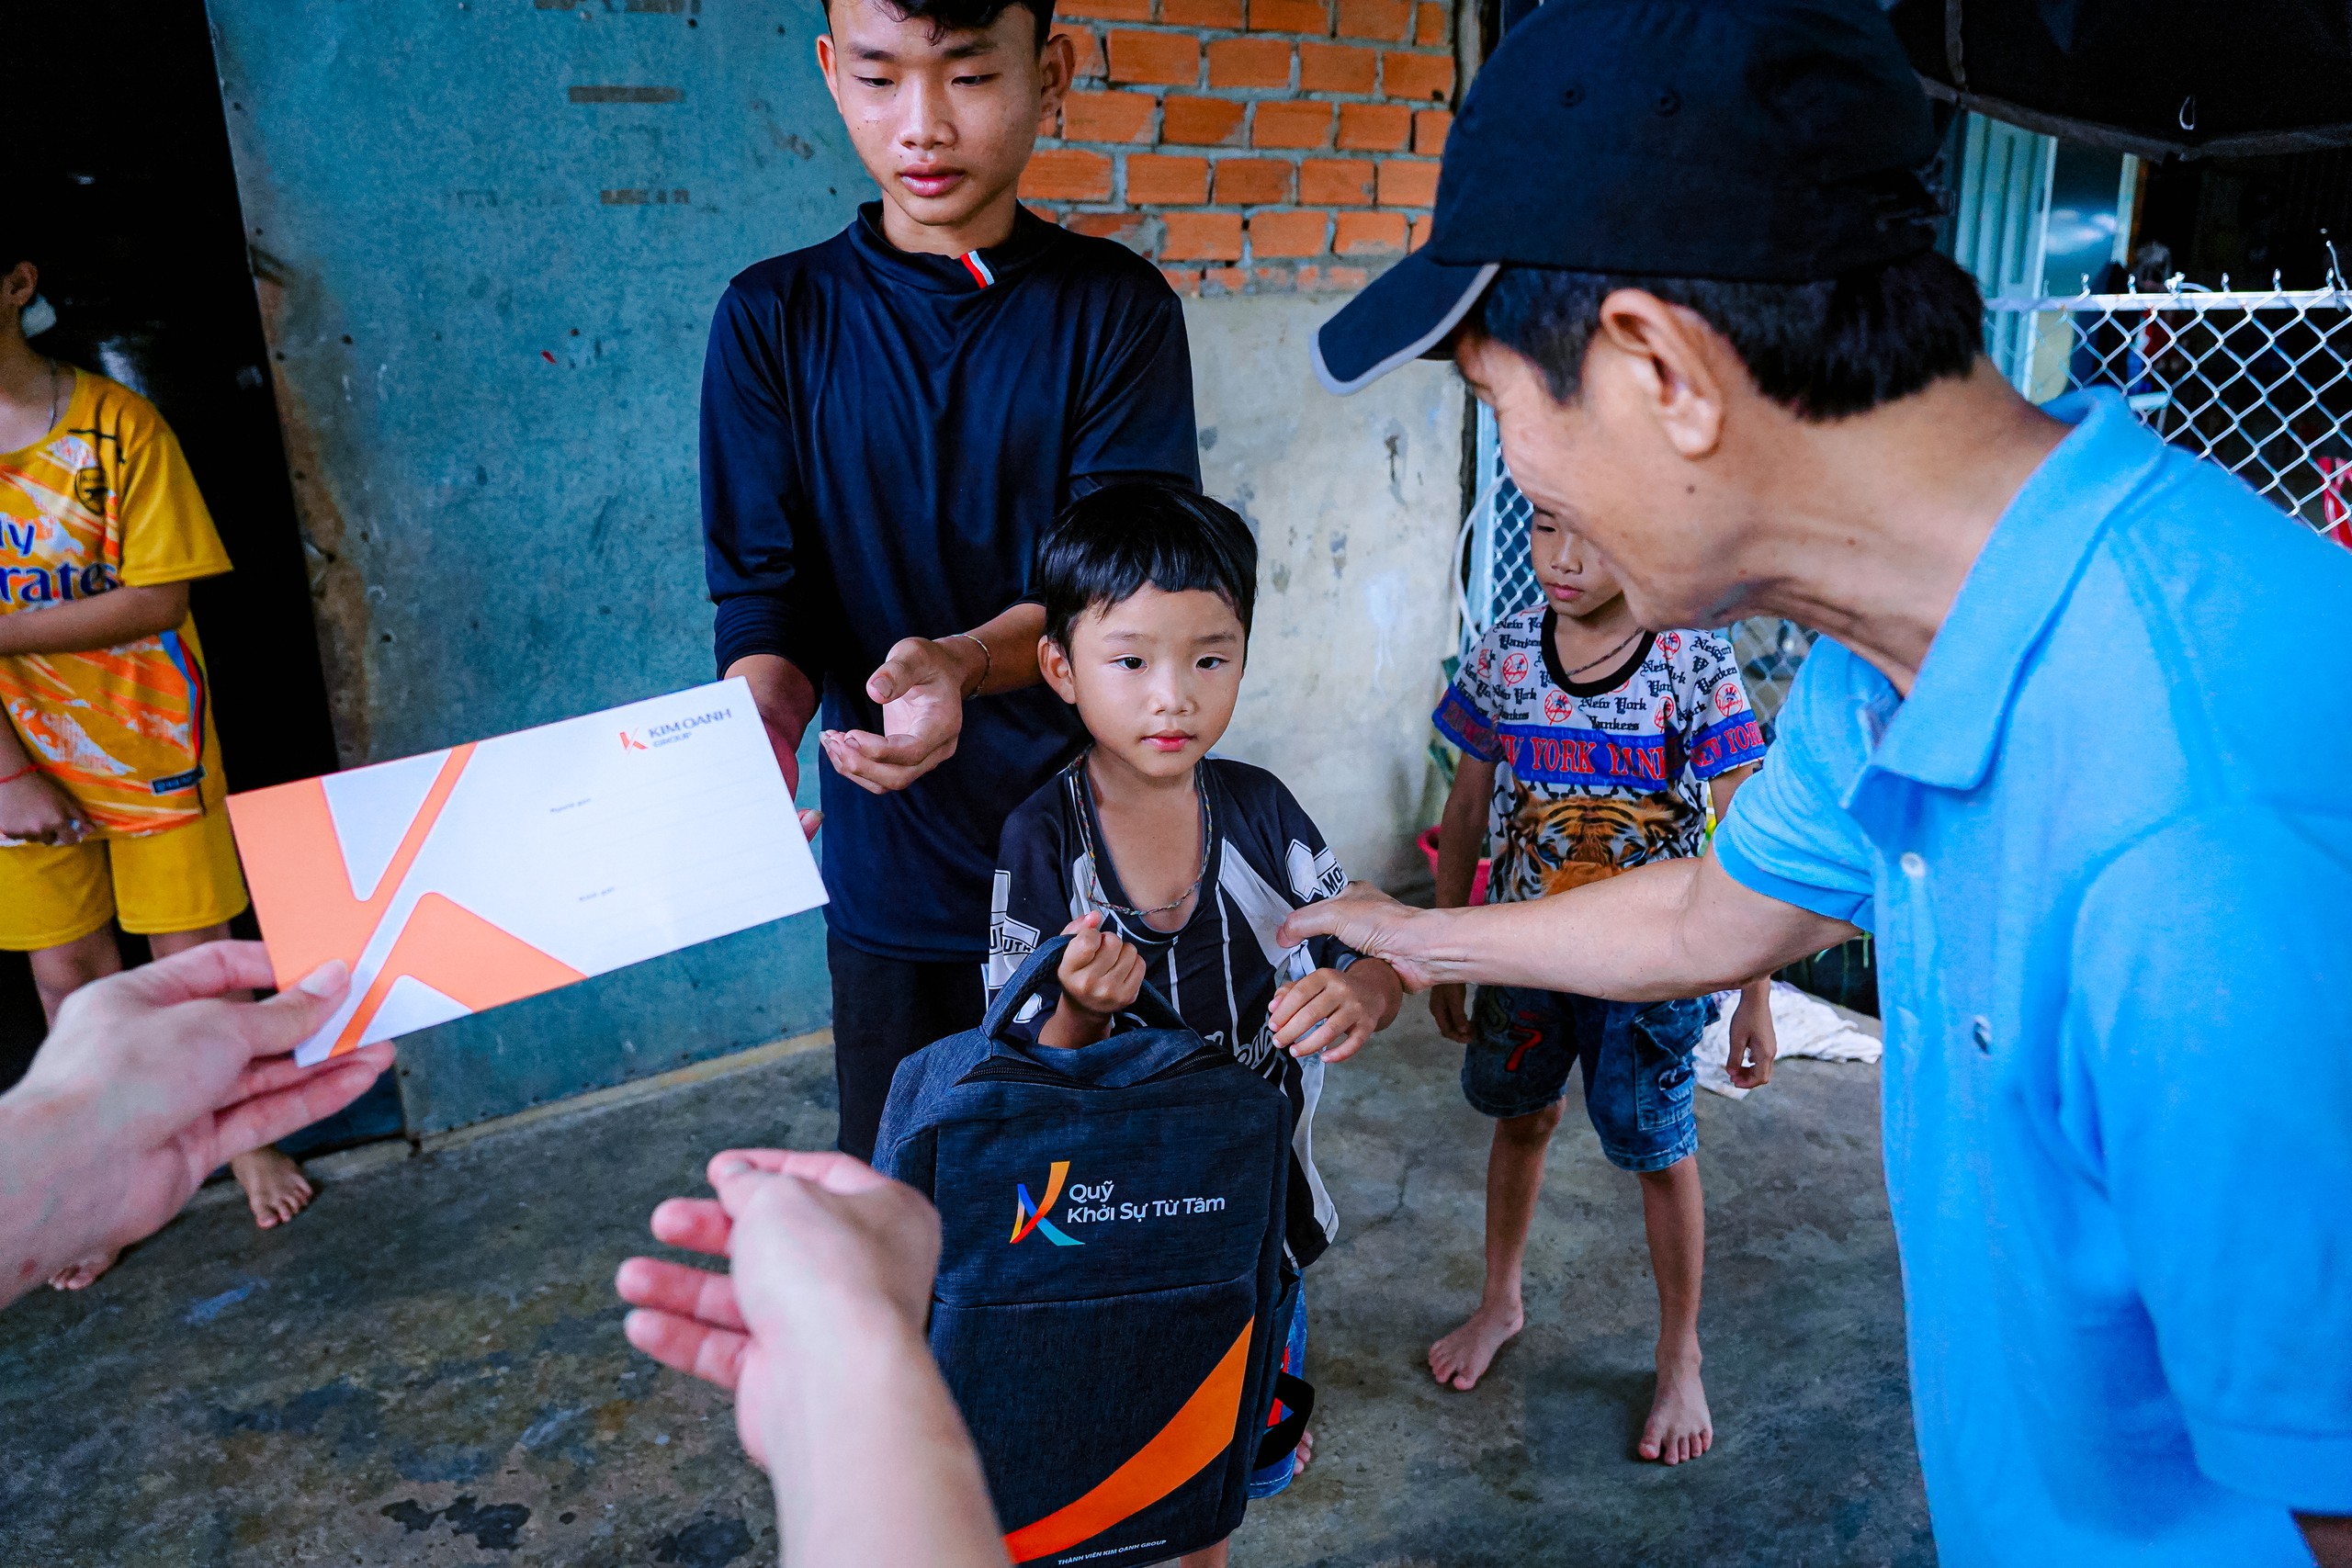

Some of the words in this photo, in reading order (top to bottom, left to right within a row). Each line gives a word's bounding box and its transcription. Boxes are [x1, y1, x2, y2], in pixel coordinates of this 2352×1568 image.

[1578, 697, 1610, 712] New
[1614, 697, 1647, 715] York
[648, 722, 681, 738] KIM
[683, 708, 732, 728] OANH
[653, 732, 692, 747] GROUP
[1530, 737, 1597, 773] YORK
[1069, 1179, 1114, 1203] Quỹ
[1067, 1203, 1115, 1224] Khởi
[1120, 1201, 1148, 1223] Sự
[1152, 1199, 1180, 1217] Từ
[1182, 1197, 1226, 1214] Tâm
[1118, 1543, 1140, 1553] OANH
[1140, 1540, 1167, 1548] GROUP
